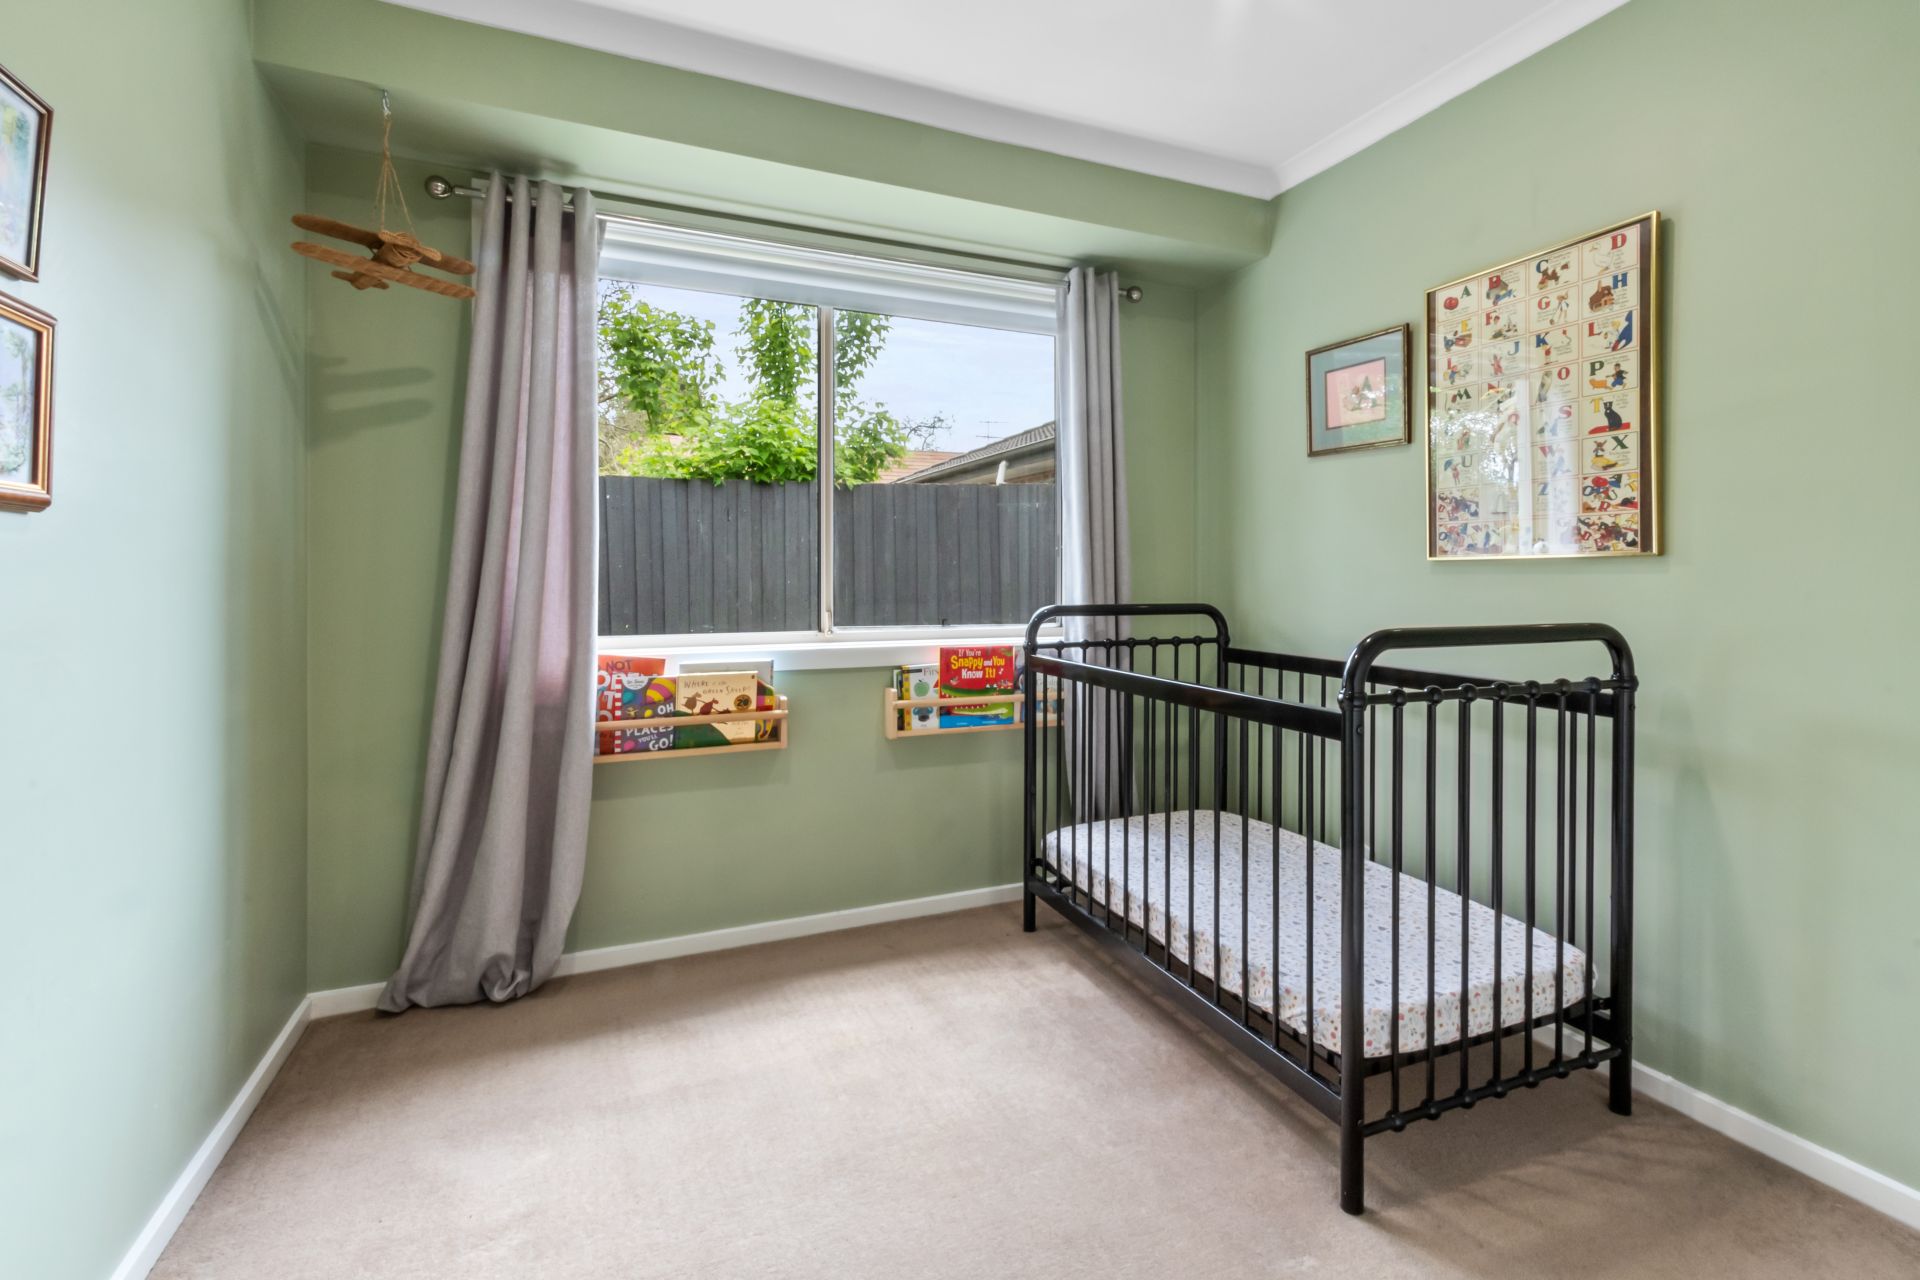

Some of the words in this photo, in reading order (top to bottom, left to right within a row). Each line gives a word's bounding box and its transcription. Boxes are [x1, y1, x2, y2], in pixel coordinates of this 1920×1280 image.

[1610, 233, 1627, 250] D
[1536, 259, 1549, 274] C
[1488, 275, 1501, 289] B
[1612, 273, 1628, 289] H
[1460, 285, 1472, 299] A
[1537, 296, 1550, 311] G
[1485, 310, 1497, 325] F
[1588, 321, 1602, 337] L
[1535, 332, 1549, 348] K
[1507, 341, 1520, 356] J
[1557, 367, 1571, 380] O
[1589, 360, 1605, 376] P
[1456, 388, 1472, 400] M
[1558, 405, 1572, 420] S
[1588, 397, 1603, 413] T
[1611, 435, 1629, 450] X
[1461, 455, 1472, 468] U
[606, 661, 631, 671] NOT
[950, 655, 984, 671] Snappy
[993, 656, 1006, 667] You
[962, 668, 984, 679] Know
[649, 733, 674, 751] GO!
